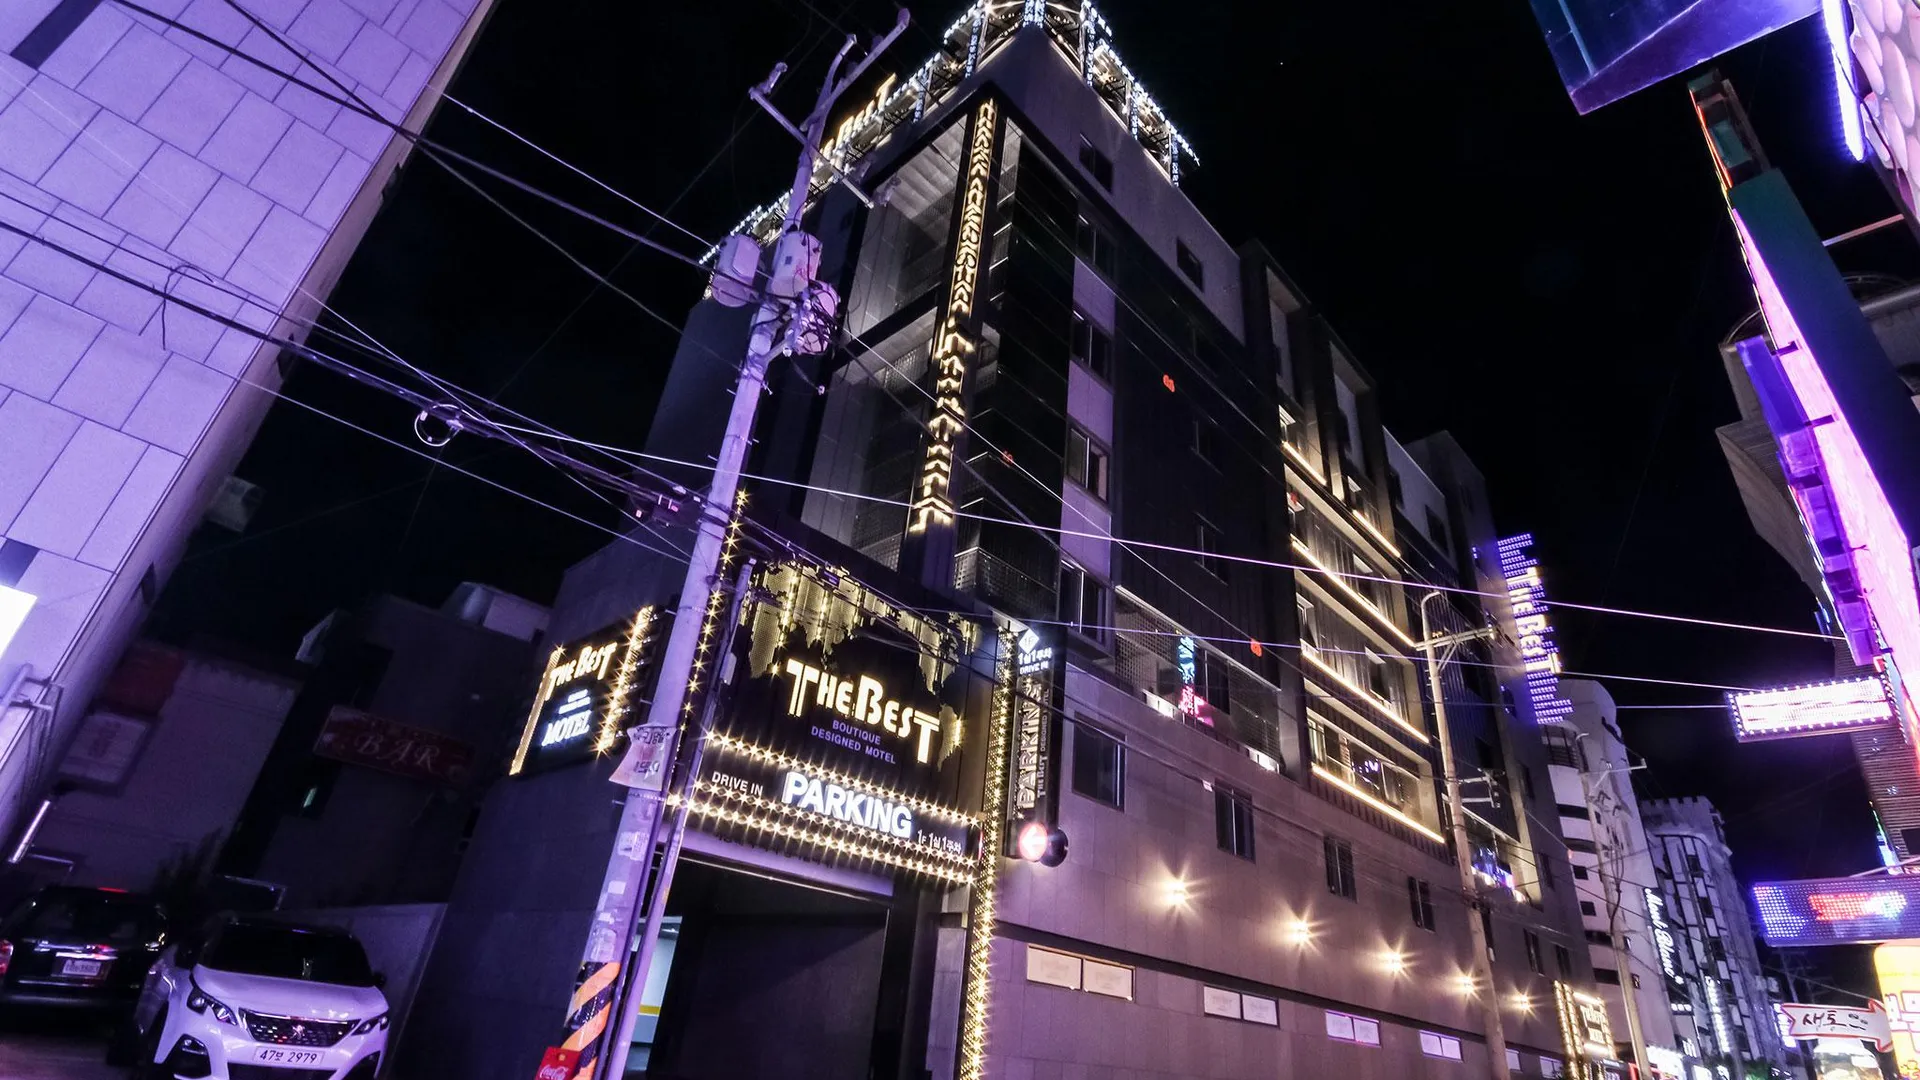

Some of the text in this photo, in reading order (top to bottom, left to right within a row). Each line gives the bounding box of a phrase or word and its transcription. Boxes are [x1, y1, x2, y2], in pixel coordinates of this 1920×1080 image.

[1505, 566, 1561, 674] THE BEST
[544, 660, 577, 702] THE
[573, 641, 618, 681] BEST
[1019, 662, 1040, 675] DRIVE
[541, 709, 592, 747] MOTEL
[786, 658, 941, 764] THE BEST
[811, 725, 897, 765] DESIGNED MOTEL
[832, 719, 882, 746] BOUTIQUE
[1017, 683, 1042, 809] PARKING
[353, 733, 441, 773] BAR
[711, 770, 764, 796] DRIVE IN
[781, 771, 912, 839] PARKING
[1644, 888, 1677, 979] Mont Blanc
[260, 1049, 318, 1065] 47보 2979
